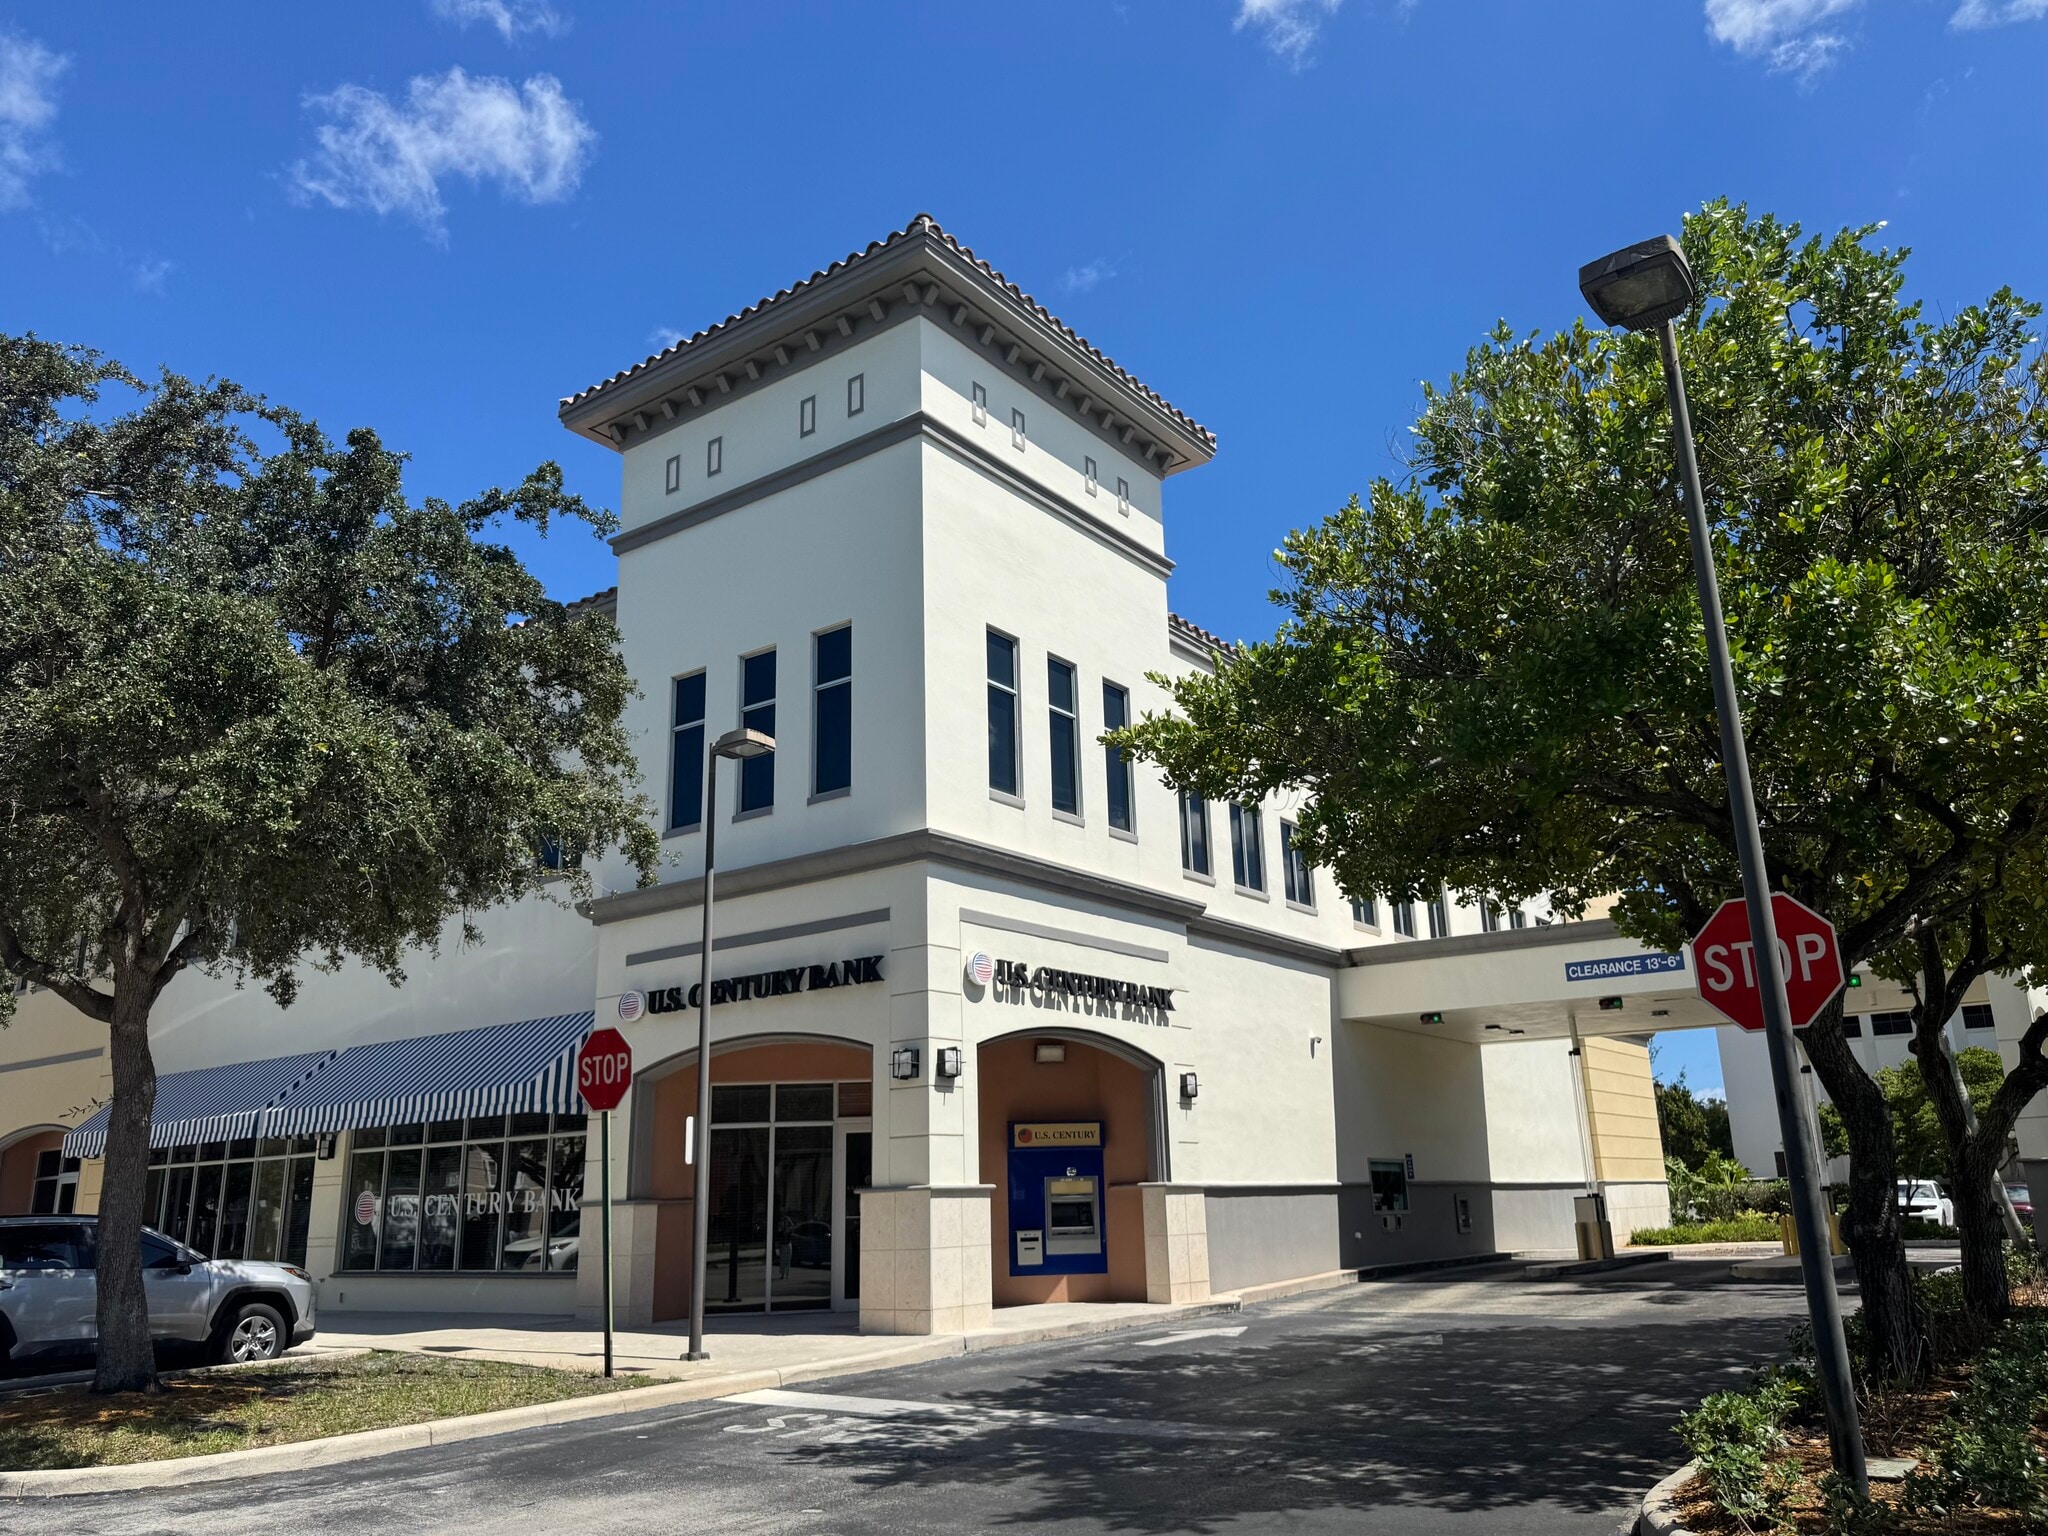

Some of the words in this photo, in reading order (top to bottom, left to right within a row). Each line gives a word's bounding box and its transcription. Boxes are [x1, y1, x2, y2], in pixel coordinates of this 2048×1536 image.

[1568, 957, 1642, 978] CLEARANCE
[1645, 955, 1681, 970] 13'-6"
[647, 986, 686, 1014] U.S.
[806, 955, 885, 990] BANK
[996, 959, 1031, 988] U.S.
[1032, 967, 1122, 1002] CENTURY
[1123, 982, 1176, 1011] BANK
[581, 1052, 629, 1087] STOP
[1034, 1131, 1051, 1140] U.S.
[1052, 1130, 1096, 1139] CENTURY
[391, 1195, 419, 1217] U.S.
[424, 1191, 519, 1216] CENTURY
[523, 1187, 580, 1213] BANK
